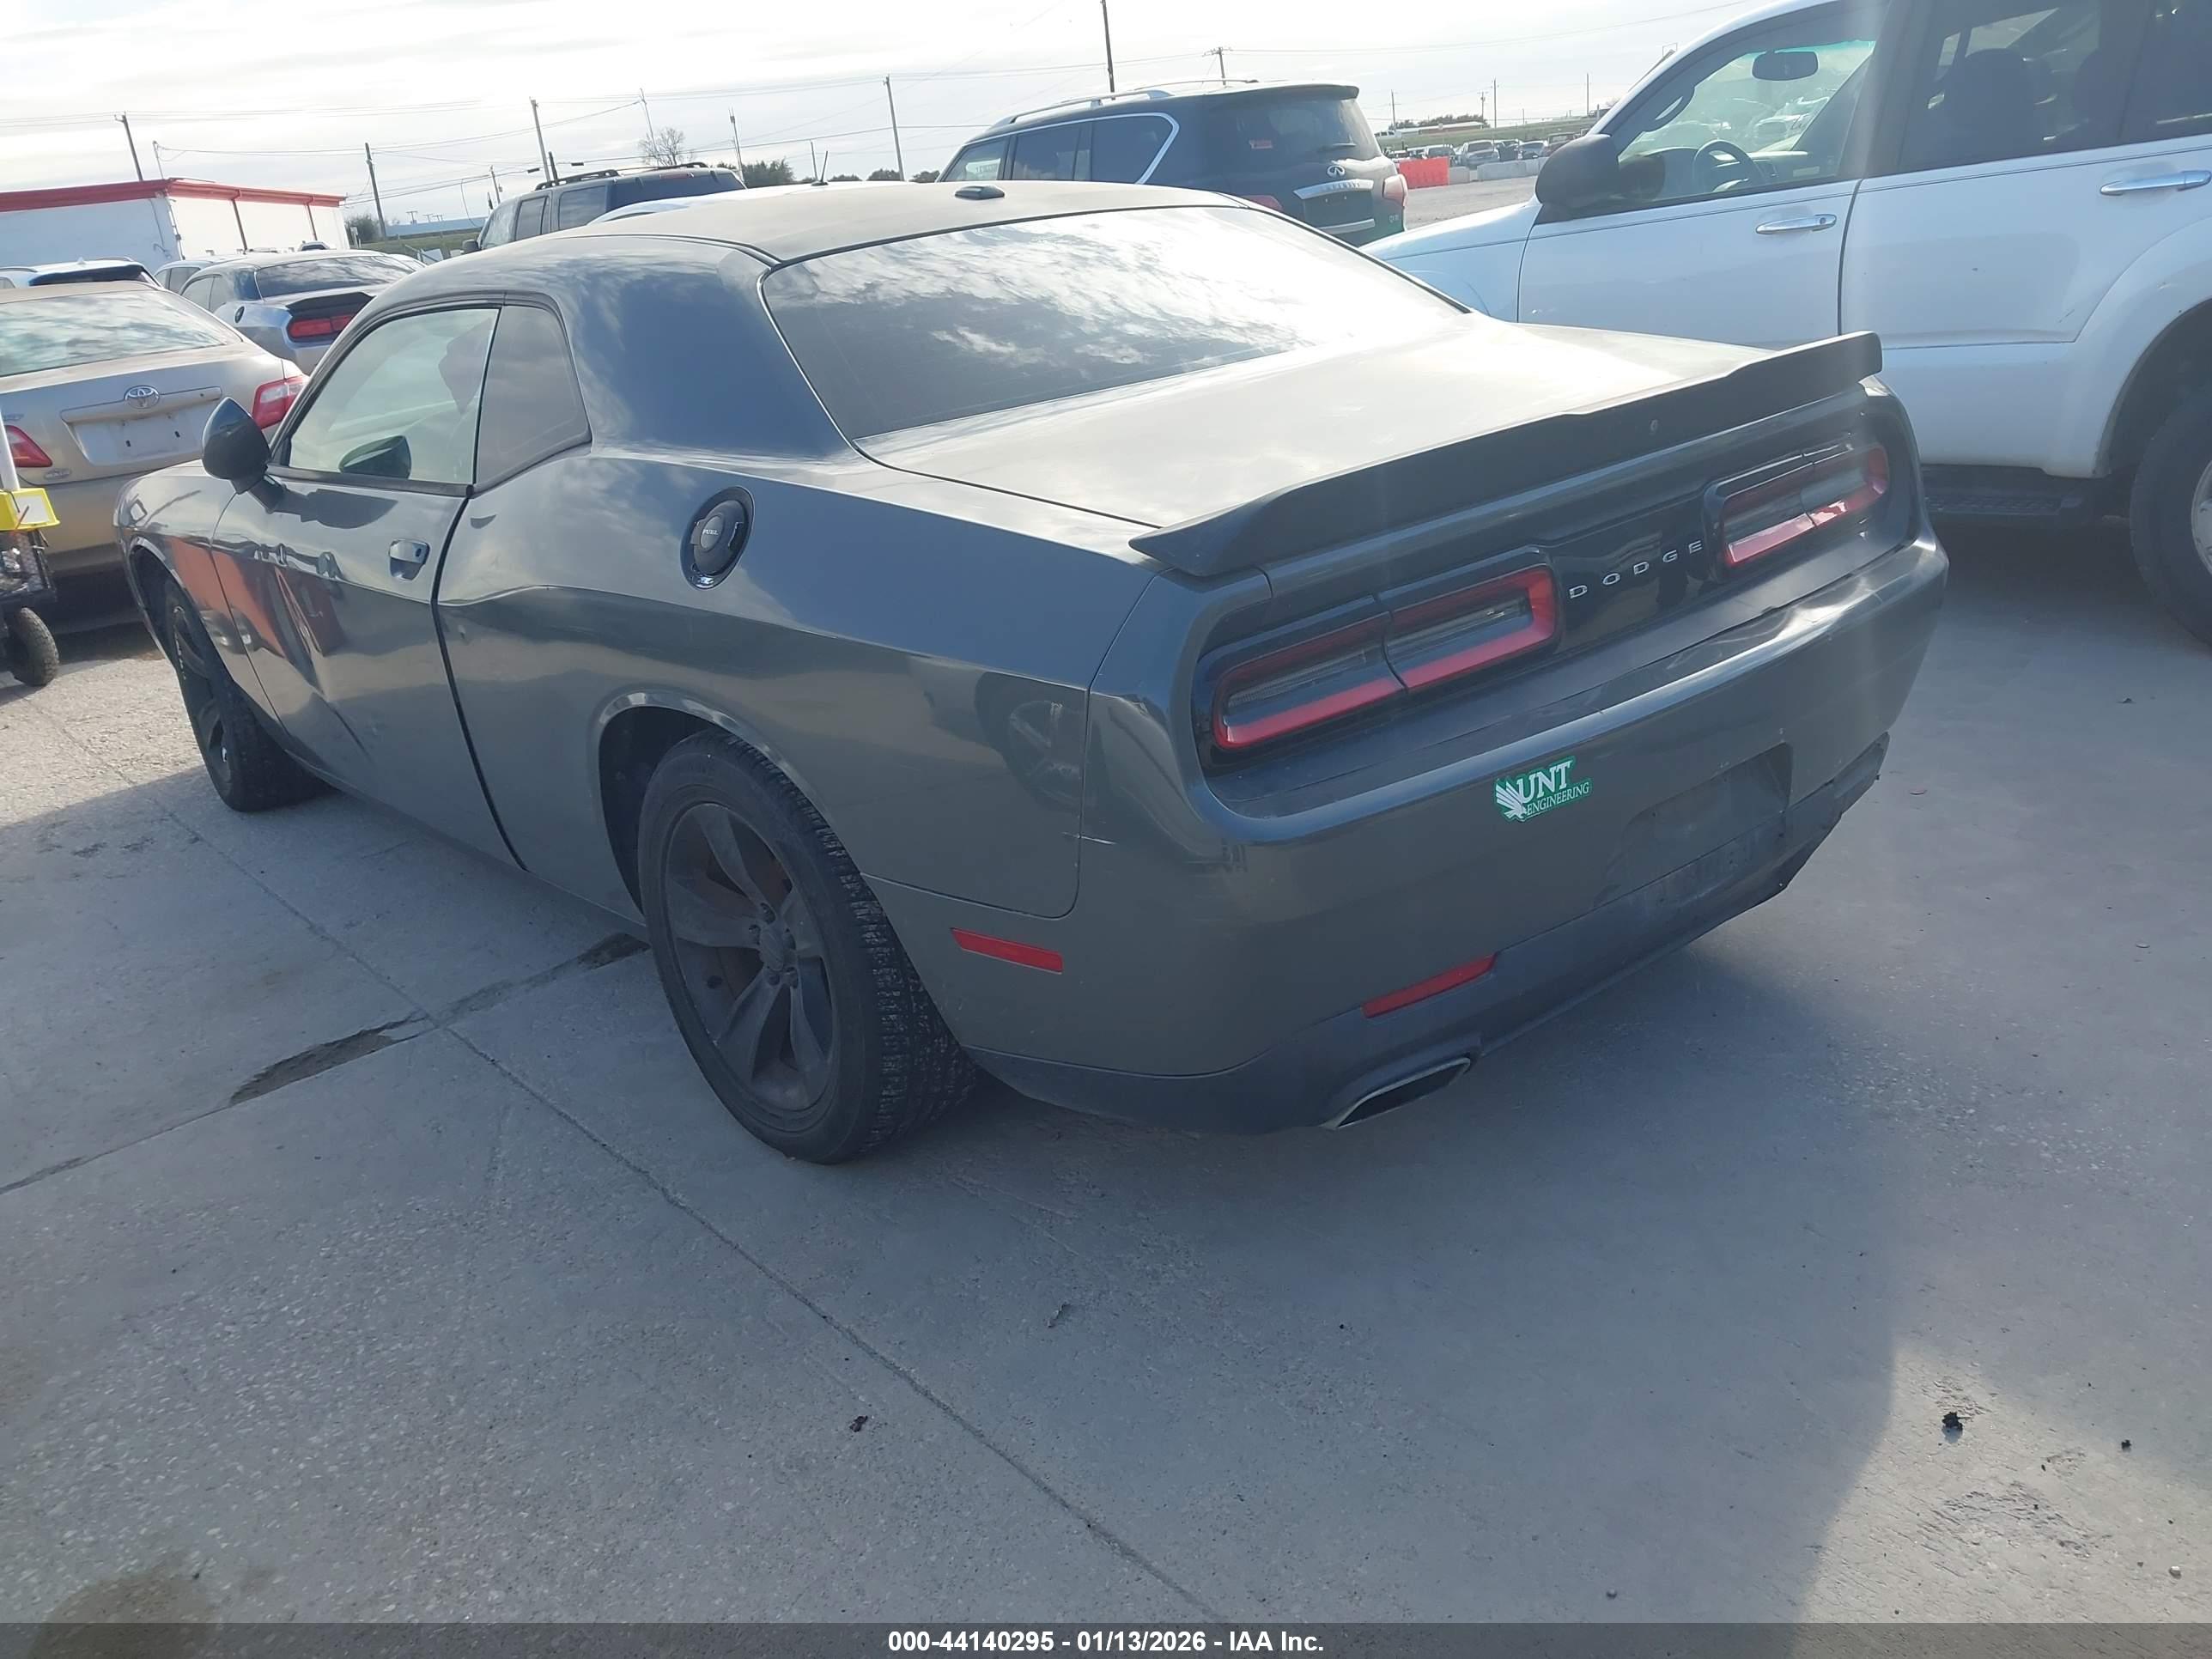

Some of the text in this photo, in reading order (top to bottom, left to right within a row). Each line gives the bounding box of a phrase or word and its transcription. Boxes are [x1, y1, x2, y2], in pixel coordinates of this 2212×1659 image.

[1569, 540, 1703, 599] DODGE
[1516, 760, 1574, 804] UNT
[1527, 781, 1590, 816] ENGINEERING
